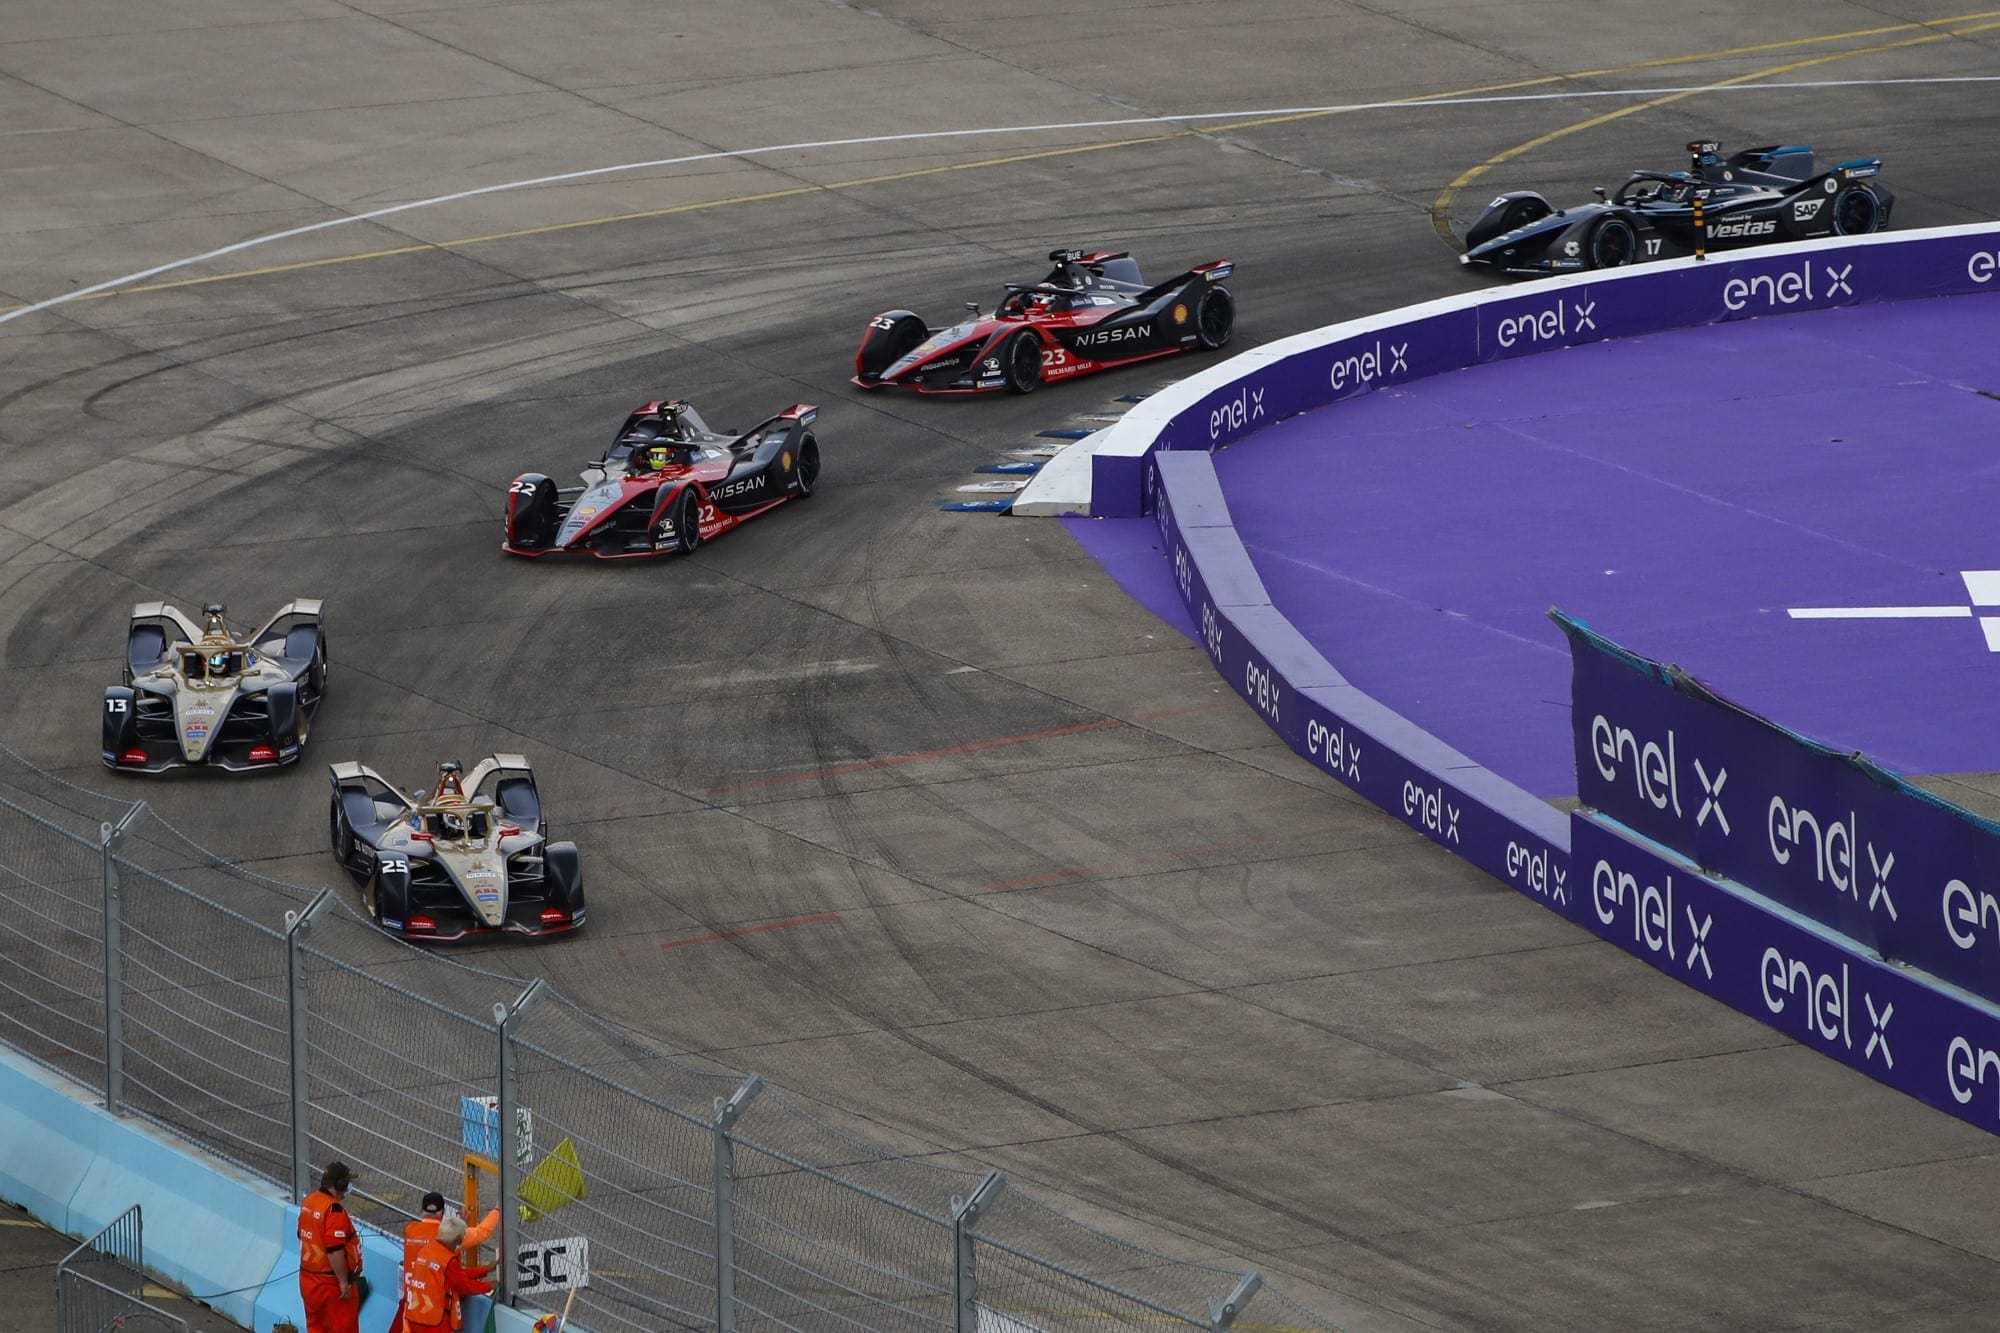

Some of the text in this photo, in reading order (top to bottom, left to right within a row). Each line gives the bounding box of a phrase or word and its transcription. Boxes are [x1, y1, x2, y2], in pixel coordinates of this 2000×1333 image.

[1702, 143, 1718, 152] DEV
[1489, 197, 1508, 208] 17
[1795, 203, 1819, 217] SAP
[1706, 219, 1776, 238] Vestas
[1721, 214, 1745, 223] Powered
[1066, 251, 1082, 262] BUE
[1645, 239, 1662, 255] 17
[1724, 260, 1813, 310] enel
[869, 316, 896, 330] 23
[1498, 299, 1566, 348] enel
[1076, 325, 1151, 347] NISSAN
[1042, 349, 1066, 366] 23
[1331, 341, 1382, 390] enel
[1210, 387, 1248, 439] enel
[509, 482, 537, 496] 22
[709, 476, 766, 501] NISSAN
[1247, 660, 1270, 717] enel
[106, 699, 127, 713] 13
[1308, 719, 1345, 773] enel
[1592, 714, 1682, 819] enel
[1404, 779, 1441, 834] enel
[1768, 795, 1858, 901] enel
[382, 860, 409, 874] 25
[1507, 841, 1548, 895] enel
[1593, 860, 1675, 960] enel
[1761, 947, 1852, 1050] enel
[517, 1246, 568, 1290] SC
